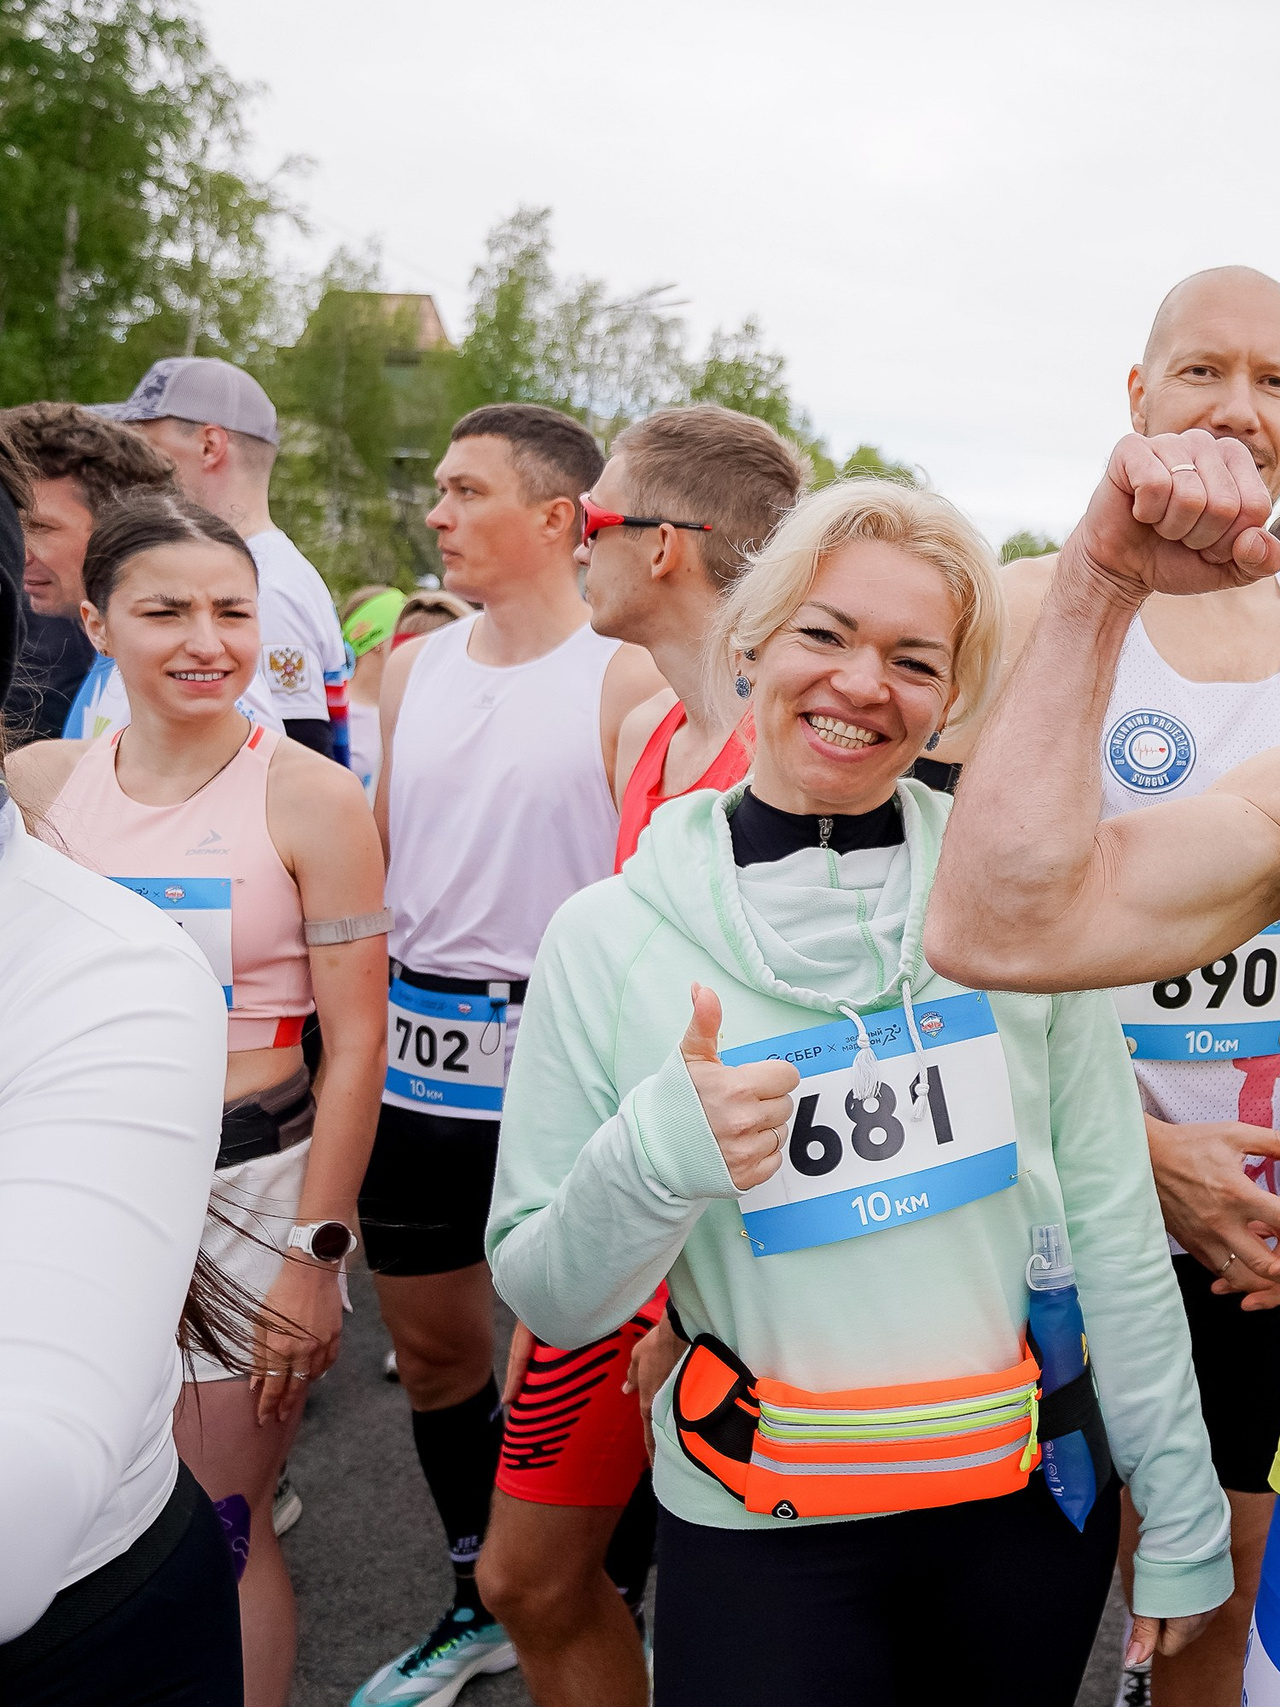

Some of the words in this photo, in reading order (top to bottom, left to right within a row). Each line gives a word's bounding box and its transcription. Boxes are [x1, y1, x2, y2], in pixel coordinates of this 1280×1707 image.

[1112, 715, 1150, 745] RUNNING
[1152, 716, 1189, 747] PROJECT
[1131, 773, 1170, 787] SURGUT
[185, 848, 231, 856] DEMIX
[396, 1016, 470, 1074] 702
[785, 1046, 822, 1063] СБЕР
[788, 1065, 954, 1177] 681
